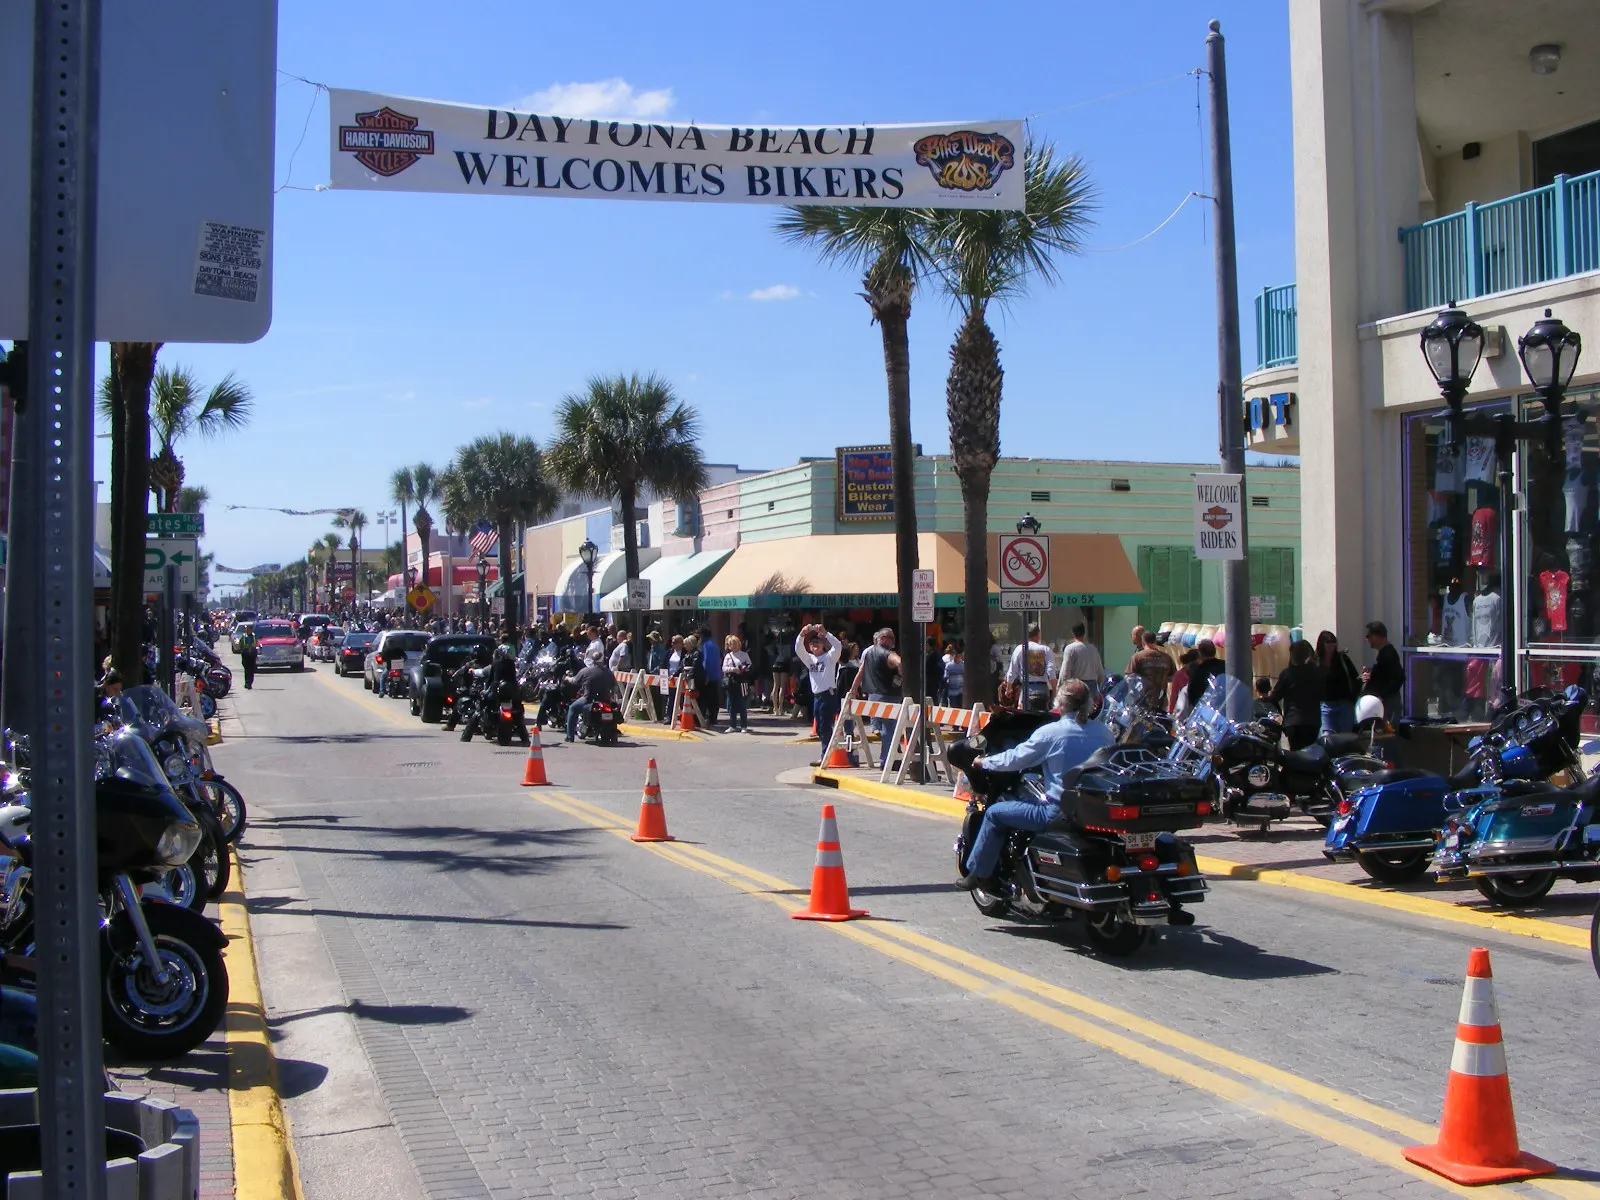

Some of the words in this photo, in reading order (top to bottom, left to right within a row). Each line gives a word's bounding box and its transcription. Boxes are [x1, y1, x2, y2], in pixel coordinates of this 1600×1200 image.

[365, 115, 409, 129] MOTOR
[484, 109, 706, 150] DAYTONA
[726, 127, 875, 156] BEACH
[345, 131, 429, 149] HARLEY-DAVIDSON
[926, 136, 961, 160] Bike
[961, 133, 1002, 163] Week
[365, 151, 409, 170] CYCLES
[453, 150, 726, 197] WELCOMES
[744, 165, 905, 201] BIKERS
[211, 227, 259, 240] WARNING
[199, 251, 222, 263] SIGNS
[199, 265, 232, 277] DAYTONA
[233, 270, 258, 281] BEACH
[1244, 392, 1295, 430] OT
[848, 492, 896, 502] Bikers
[1197, 485, 1239, 503] WELCOME
[857, 502, 888, 512] Wear
[1200, 531, 1237, 549] RIDERS
[919, 573, 928, 581] NO
[914, 582, 934, 590] PARKING
[810, 595, 837, 607] FROM
[840, 594, 856, 606] THE
[858, 593, 885, 606] BEACH
[1006, 600, 1046, 608] SIDEWALK
[1067, 596, 1078, 605] to
[1081, 595, 1096, 605] 5X
